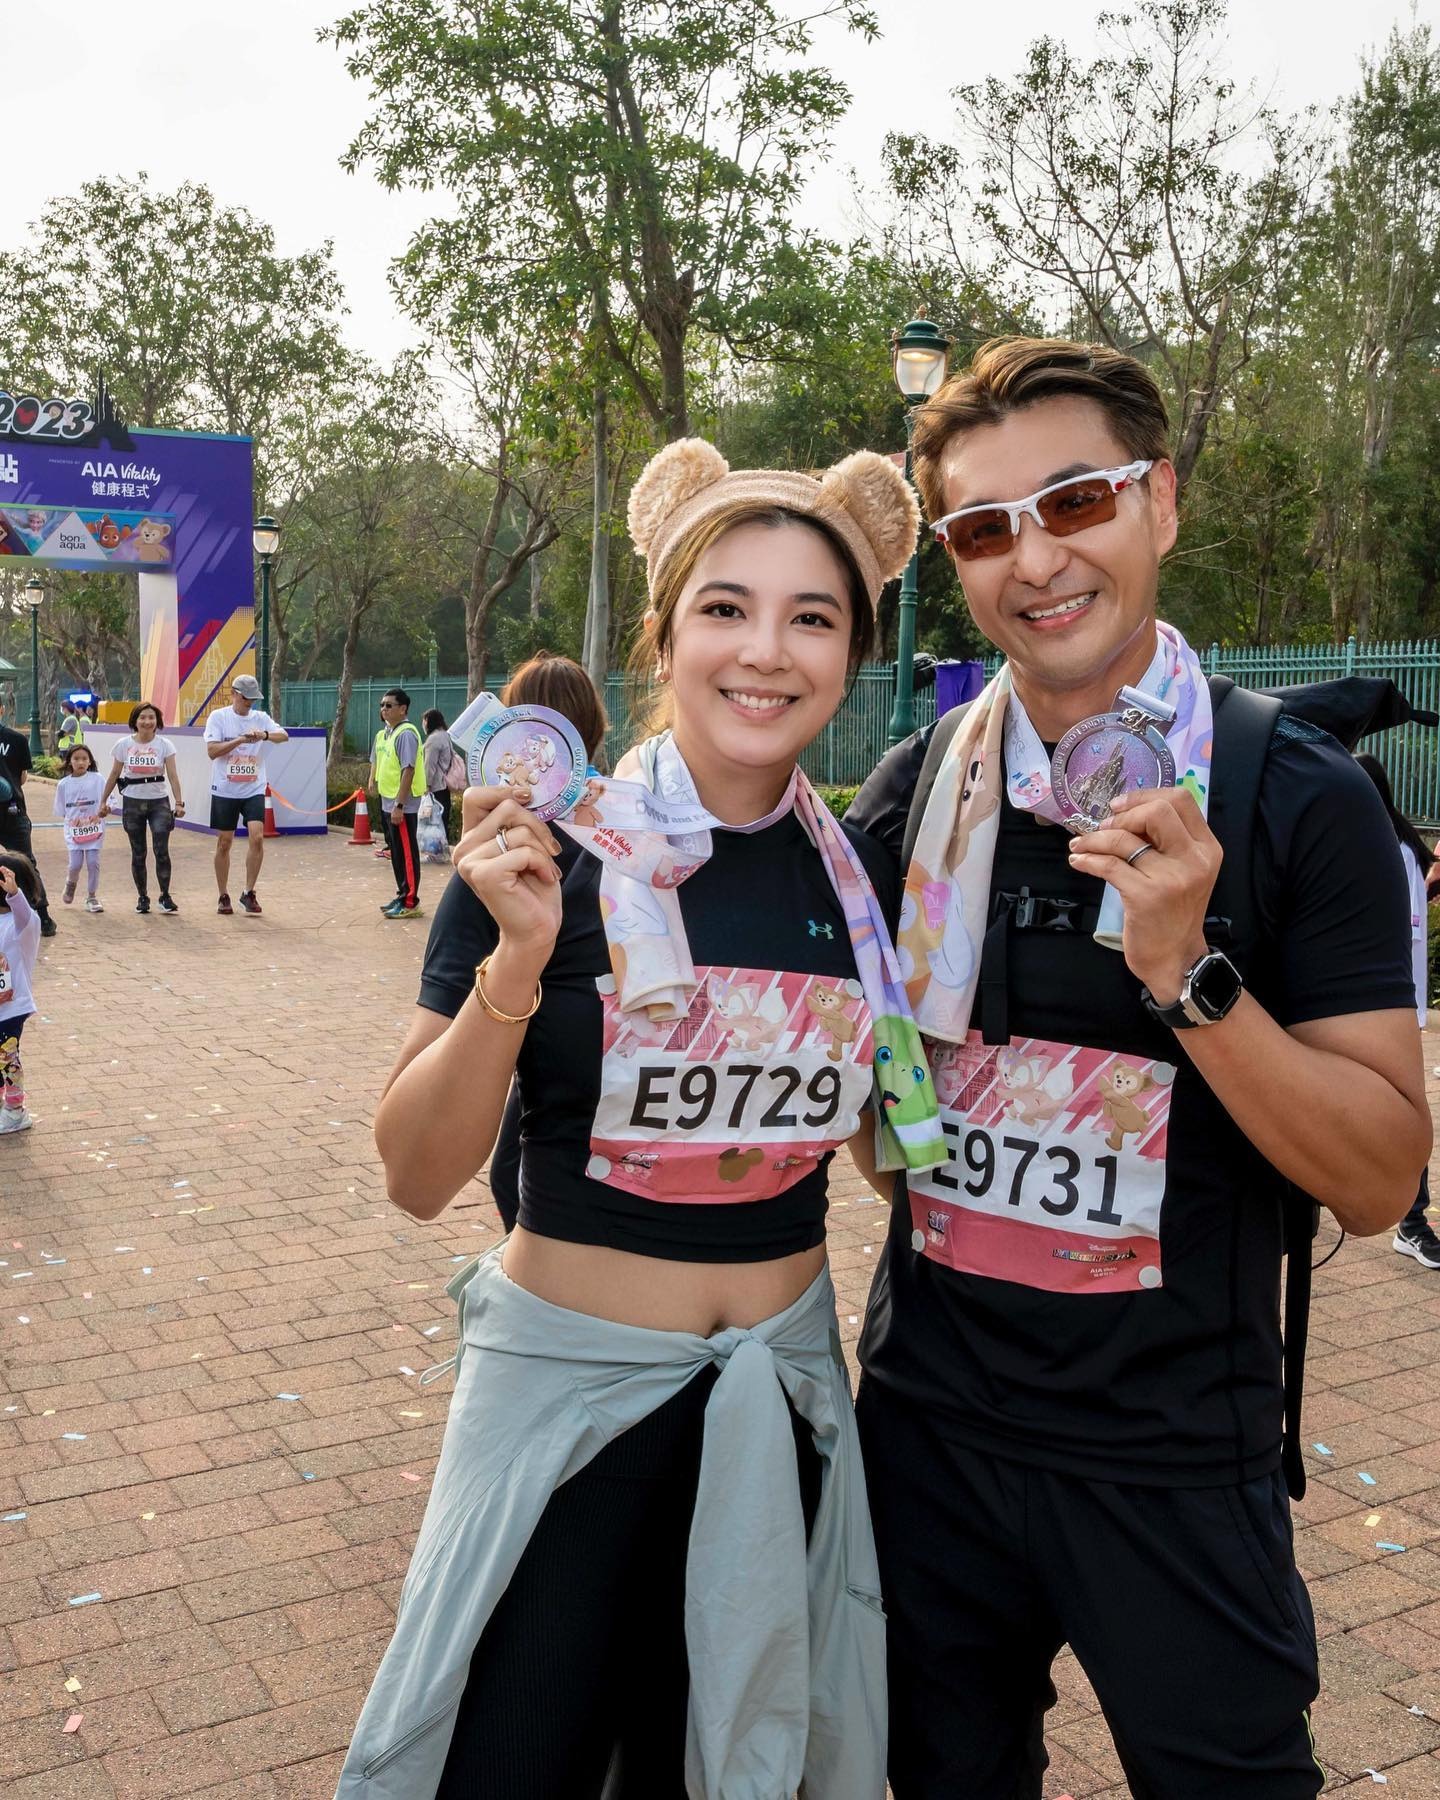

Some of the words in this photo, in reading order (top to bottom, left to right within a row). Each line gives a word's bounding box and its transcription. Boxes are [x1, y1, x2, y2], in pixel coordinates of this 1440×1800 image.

[81, 461, 119, 479] AIA
[121, 462, 161, 486] Vitality
[91, 480, 150, 499] 健康程式
[59, 541, 86, 551] aqua
[60, 532, 80, 542] bon
[129, 756, 156, 766] E8910
[230, 765, 256, 775] E9505
[543, 799, 567, 818] KONG
[564, 746, 584, 801] DISNEYLAND
[73, 825, 99, 837] E8990
[613, 834, 634, 857] Vitality
[629, 1064, 842, 1130] E9729
[931, 1121, 1123, 1226] E9731
